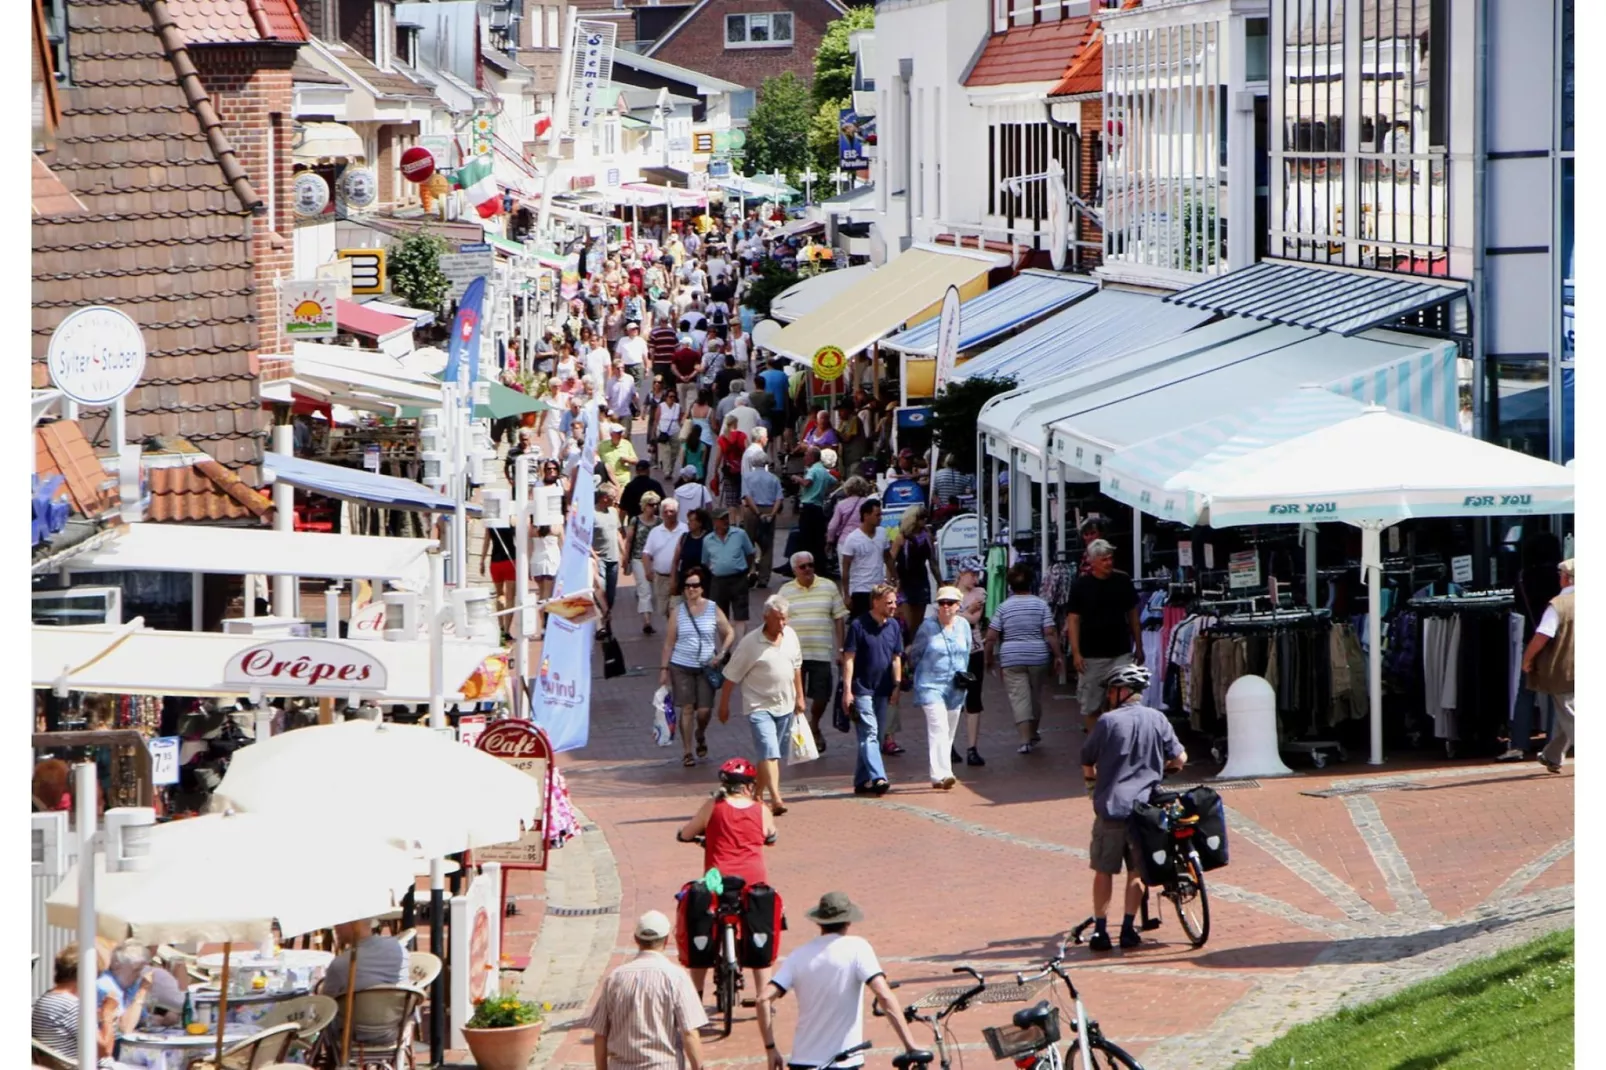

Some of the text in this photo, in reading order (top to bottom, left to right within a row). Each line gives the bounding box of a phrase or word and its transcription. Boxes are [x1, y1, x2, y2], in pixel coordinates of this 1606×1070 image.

[582, 34, 602, 127] Seemeile
[59, 346, 137, 379] Sylter Stuben
[1269, 502, 1337, 515] FOR YOU
[1463, 494, 1532, 507] FOR YOU
[240, 649, 372, 686] Crêpes
[485, 734, 537, 757] Café
